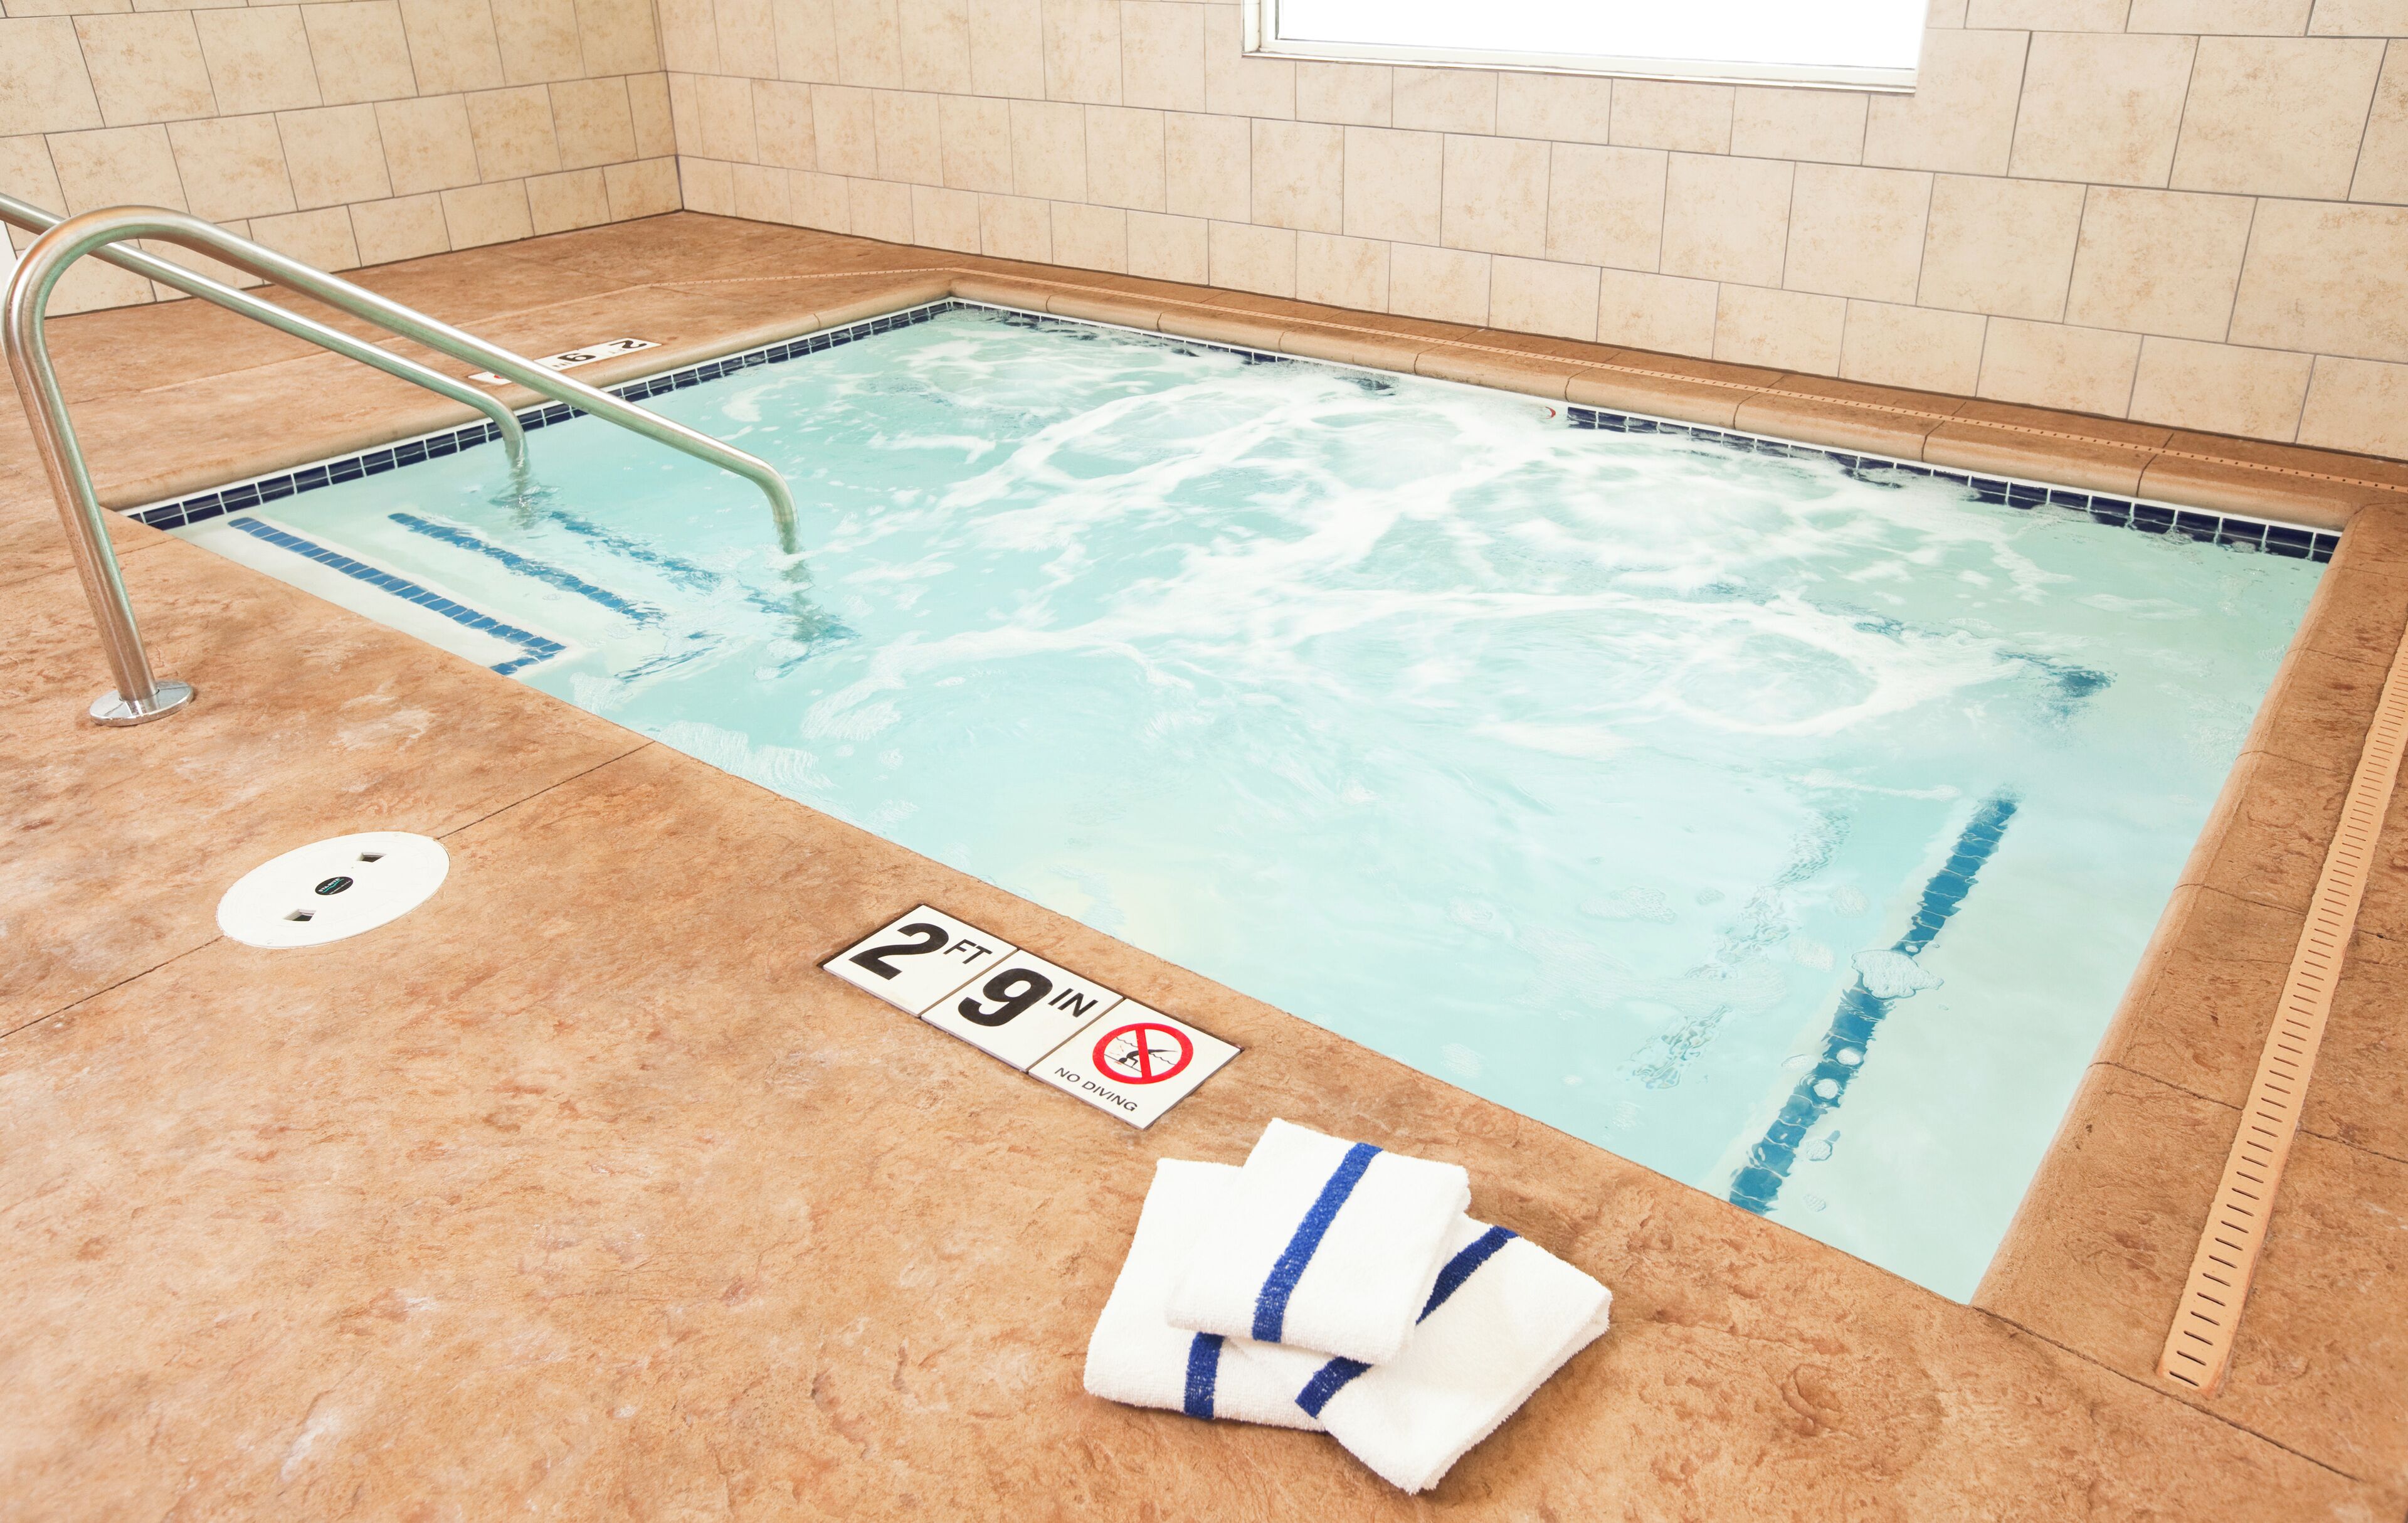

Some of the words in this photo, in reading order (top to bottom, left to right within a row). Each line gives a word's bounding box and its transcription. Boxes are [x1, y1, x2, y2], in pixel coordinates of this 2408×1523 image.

[609, 340, 647, 349] 2
[849, 923, 949, 980] 2
[943, 939, 993, 965] FT
[958, 968, 1053, 1027] 9
[1048, 988, 1099, 1018] IN
[1054, 1067, 1080, 1083] NO
[1082, 1081, 1138, 1112] DIVING
